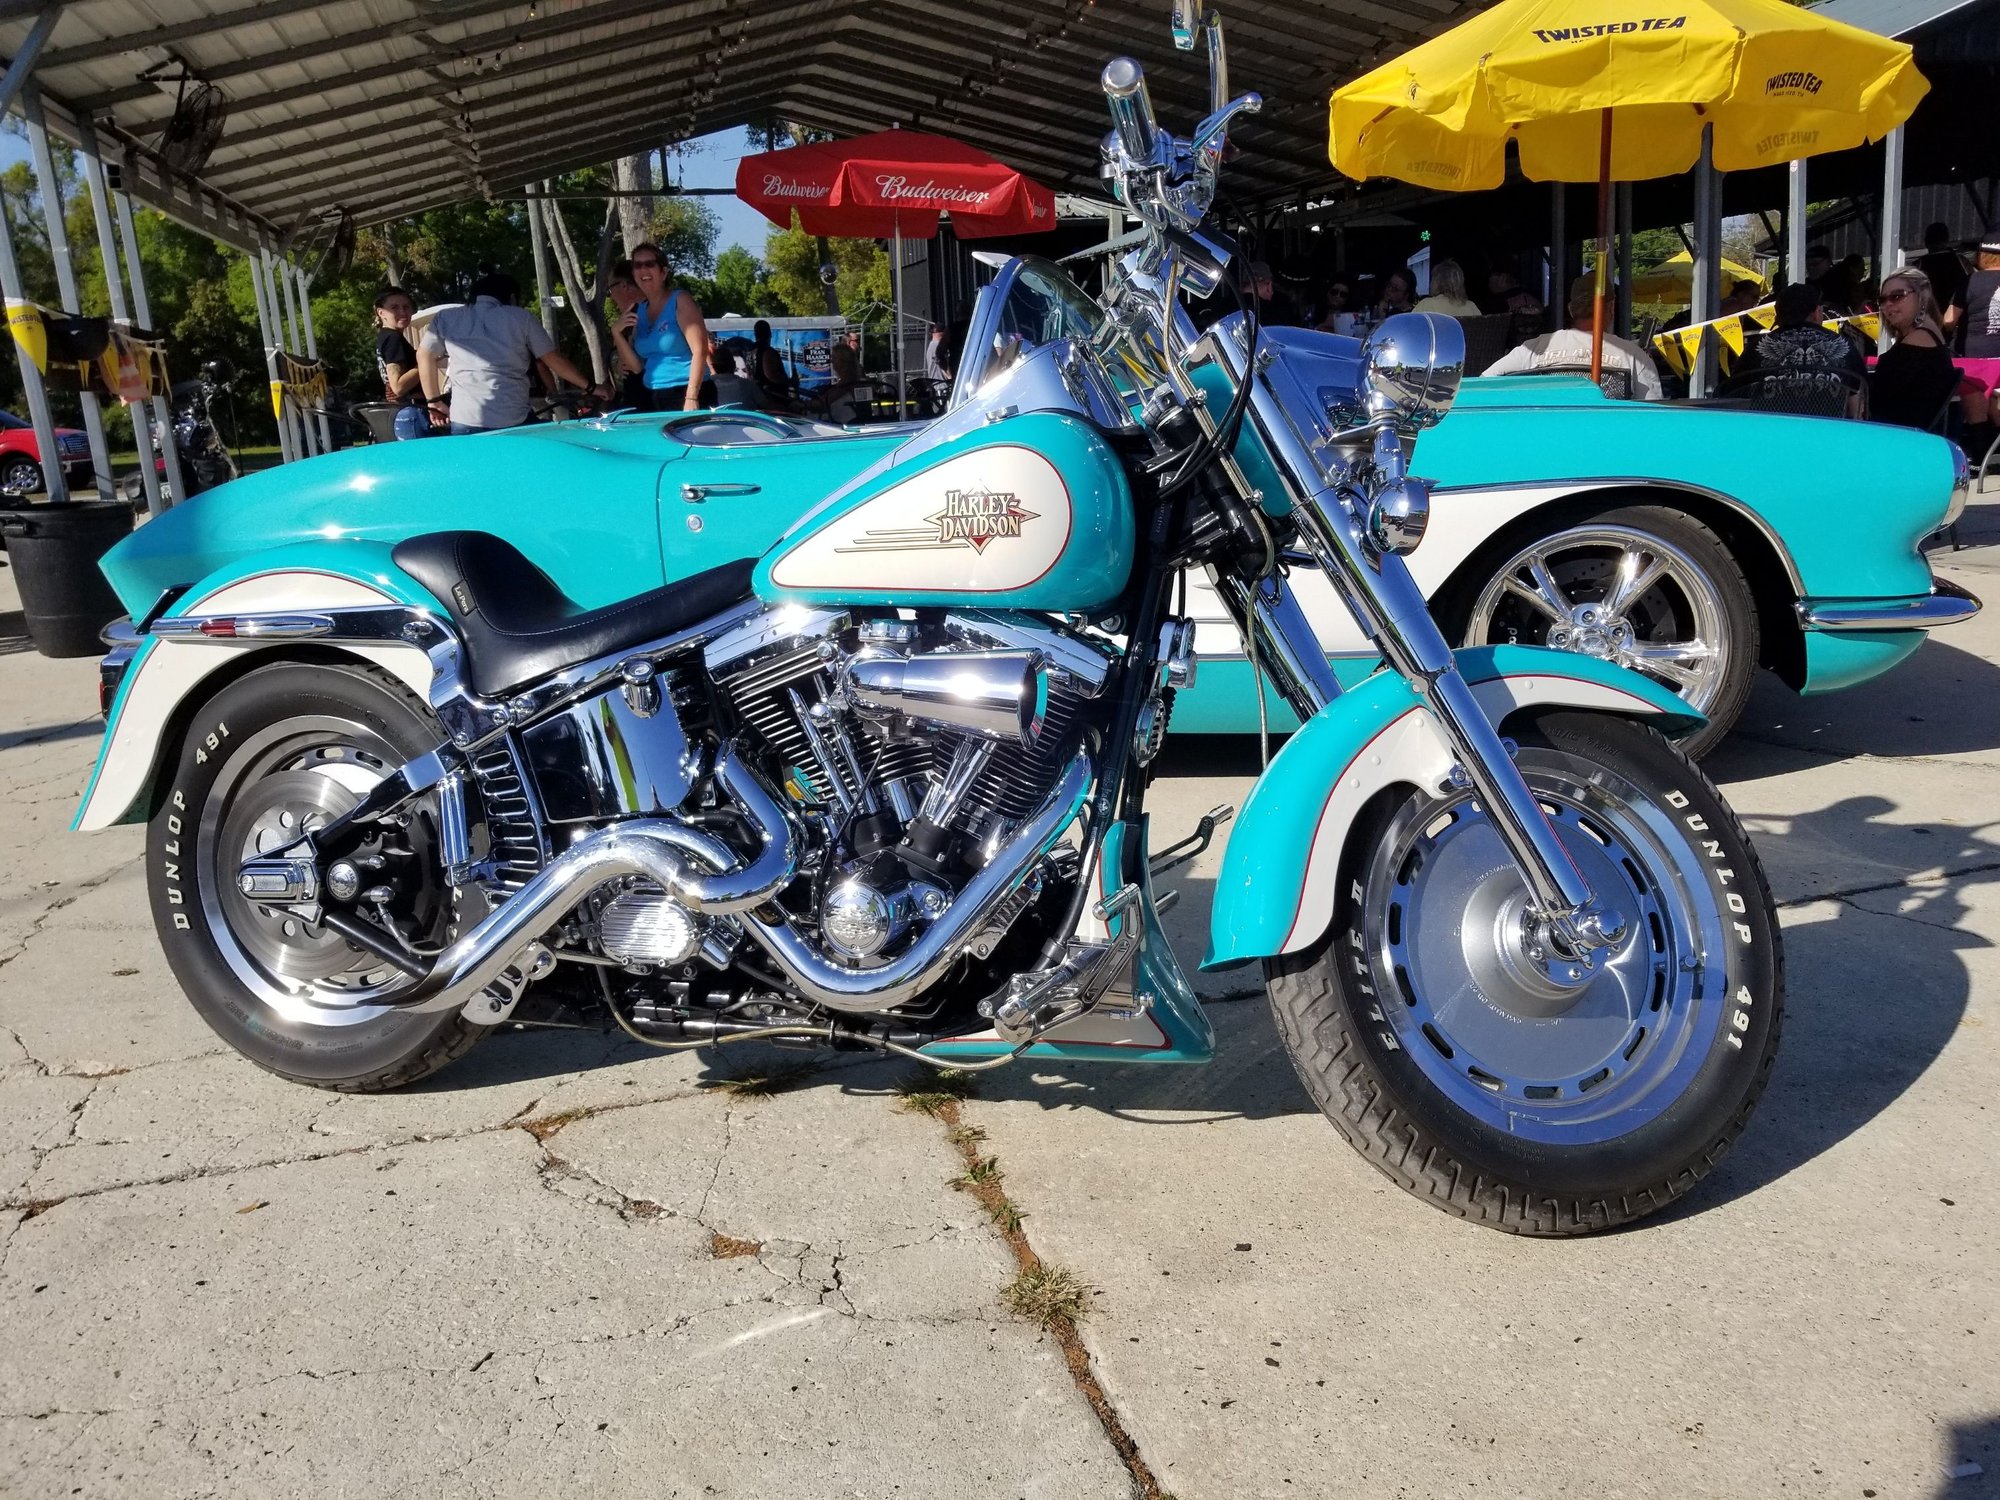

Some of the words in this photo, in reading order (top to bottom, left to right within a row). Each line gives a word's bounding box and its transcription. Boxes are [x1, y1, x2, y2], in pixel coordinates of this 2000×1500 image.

[1532, 22, 1638, 43] TWISTED
[1641, 16, 1687, 31] TEA
[1765, 72, 1804, 95] TWISTED
[1803, 72, 1823, 95] TEA
[875, 174, 990, 204] Budweiser
[939, 515, 1021, 542] DAVIDSON
[165, 790, 191, 930] DUNLOP
[196, 722, 230, 765] 491
[1664, 789, 1752, 944] DUNLOP
[1727, 985, 1753, 1050] 491
[1351, 928, 1400, 1051] ELITE
